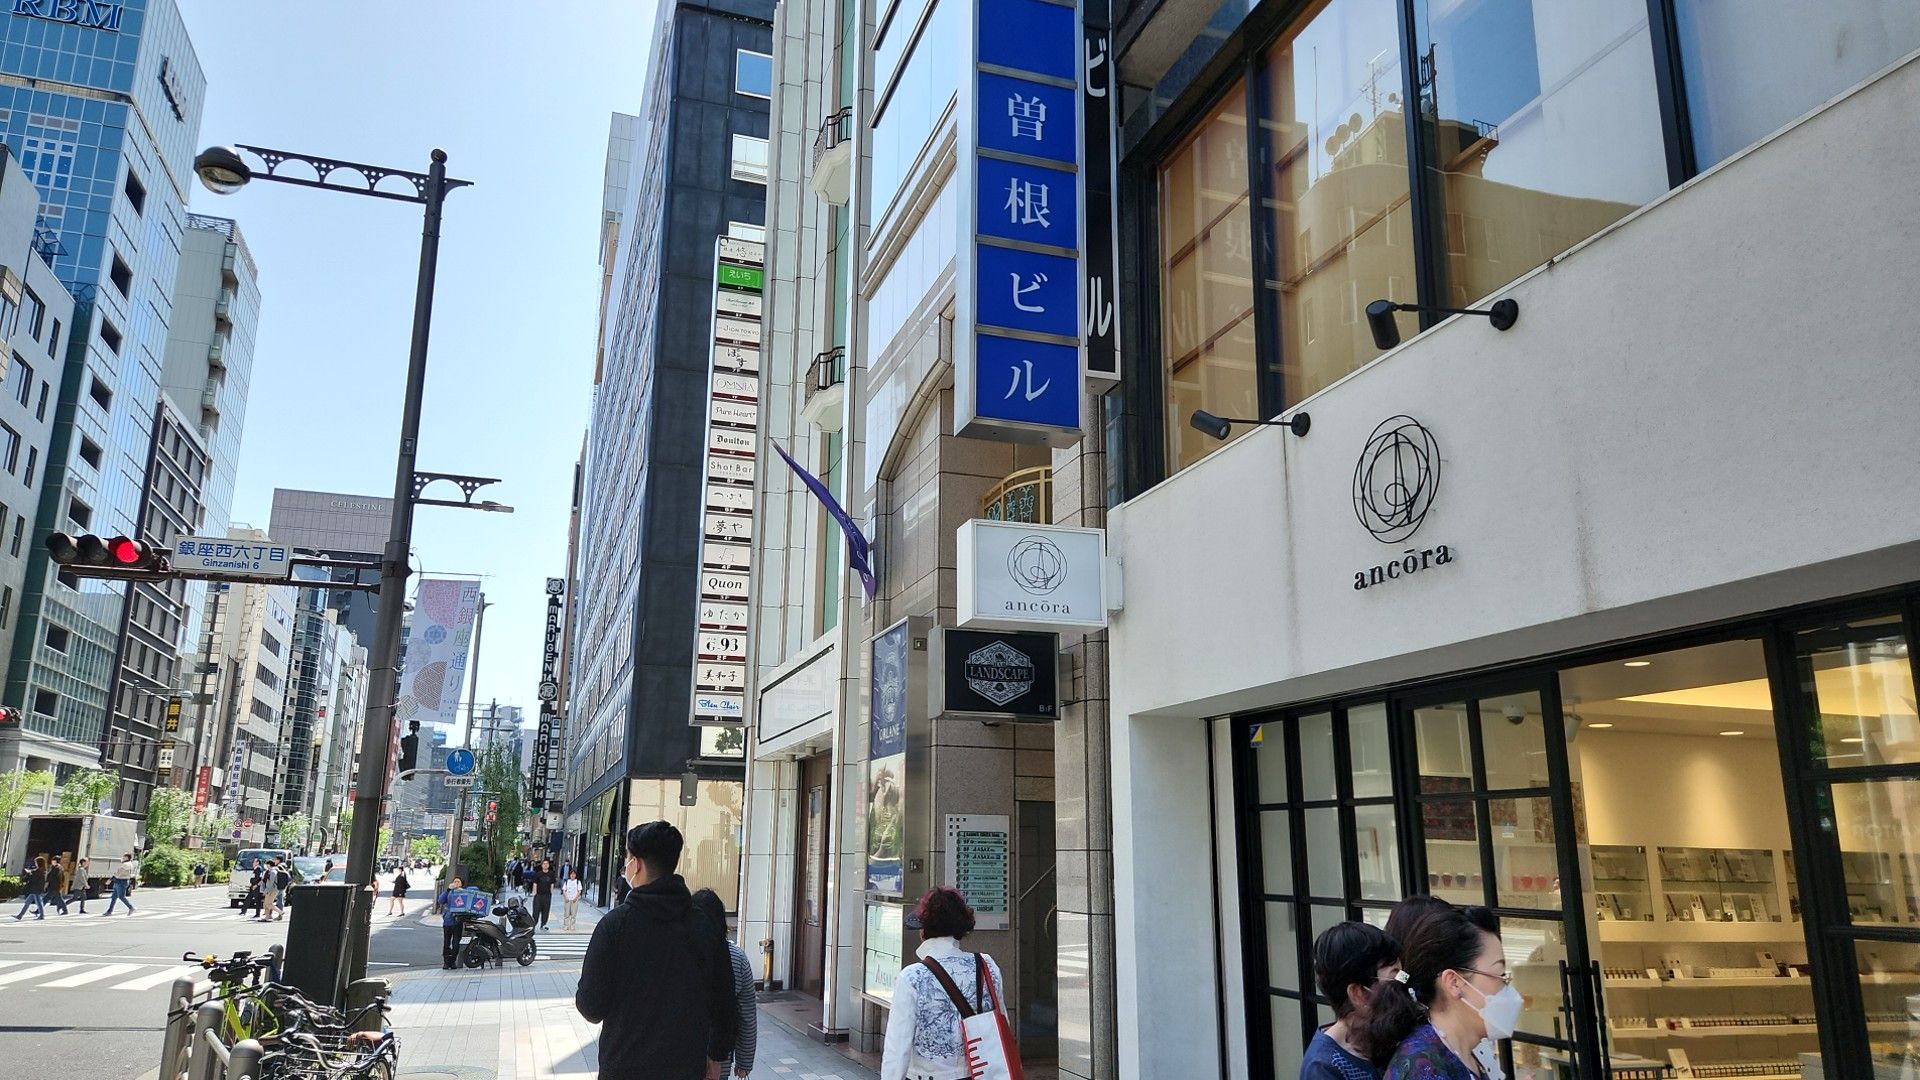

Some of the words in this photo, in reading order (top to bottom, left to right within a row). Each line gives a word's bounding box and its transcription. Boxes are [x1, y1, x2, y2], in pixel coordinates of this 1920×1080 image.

[1003, 92, 1051, 402] 曽根ビル
[716, 434, 750, 446] Doulton
[710, 461, 732, 471] Shot
[736, 463, 752, 473] Bar
[330, 501, 384, 511] CELESTINE
[178, 541, 285, 561] 銀座西六丁目
[202, 558, 250, 569] Ginzanishi
[252, 562, 260, 570] 6
[708, 577, 742, 590] Quon
[703, 608, 745, 621] ゆたか
[448, 586, 478, 692] 西銀座通り
[545, 605, 558, 671] MARUGEN
[702, 668, 738, 682] 美和子
[970, 665, 1030, 681] LANDSCAPE
[720, 701, 741, 710] Clair
[535, 713, 551, 787] MARUGEN
